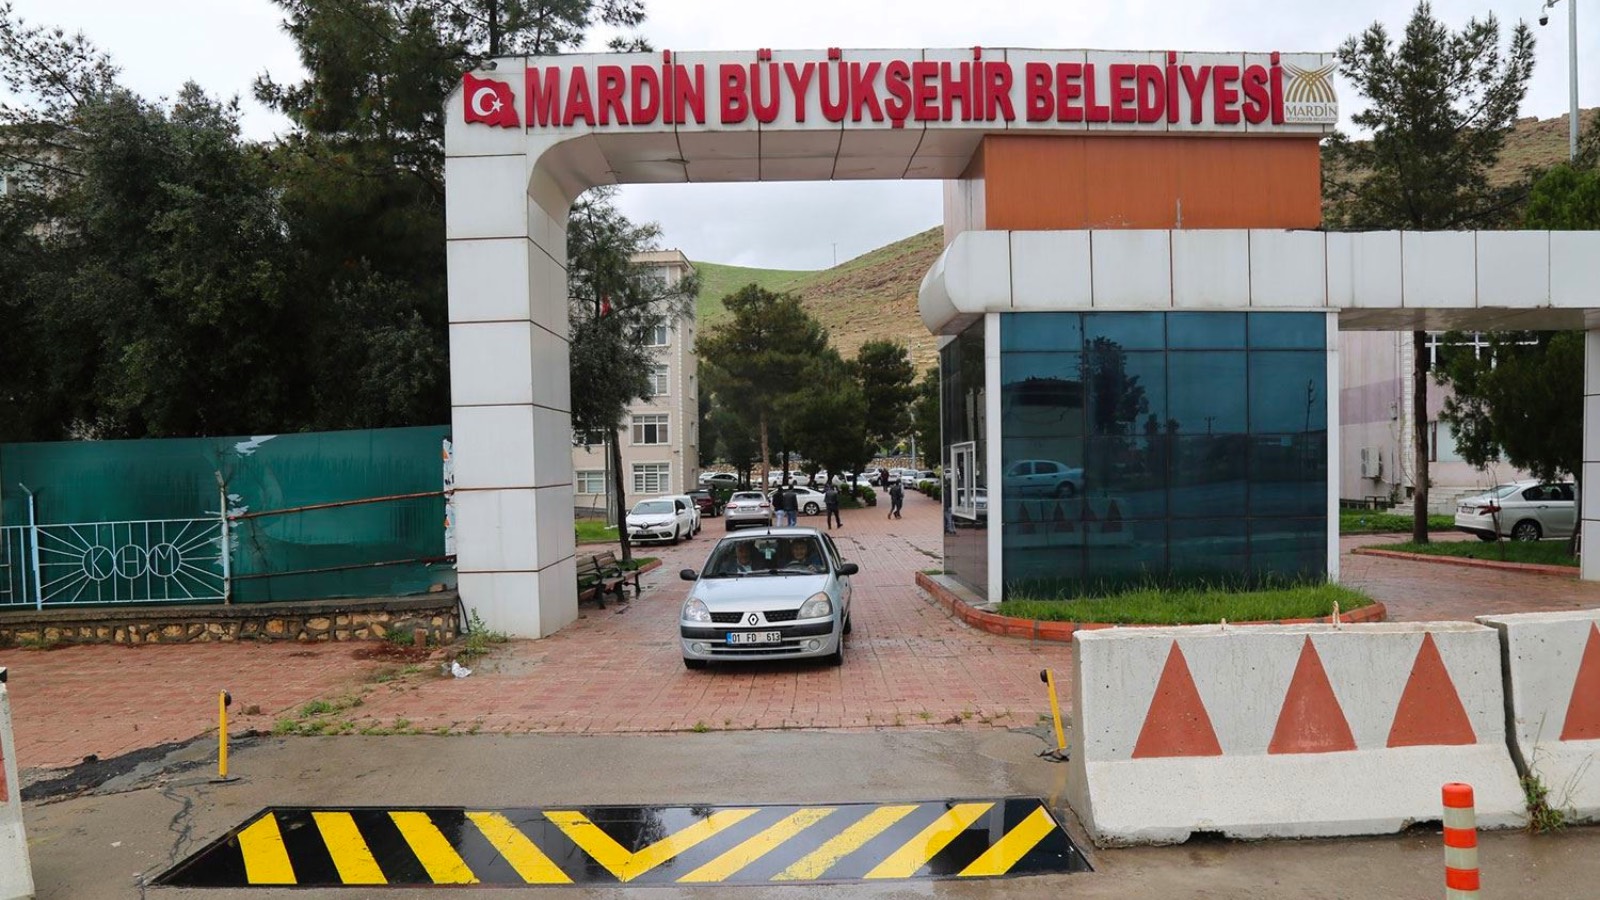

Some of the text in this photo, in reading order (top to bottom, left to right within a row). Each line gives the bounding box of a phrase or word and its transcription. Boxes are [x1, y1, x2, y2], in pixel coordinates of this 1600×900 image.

[525, 46, 1285, 130] MARDİN BÜYÜKŞEHİR BELEDİYESİ
[1285, 103, 1337, 117] MARDİN
[732, 633, 740, 642] 01
[766, 632, 780, 642] 613
